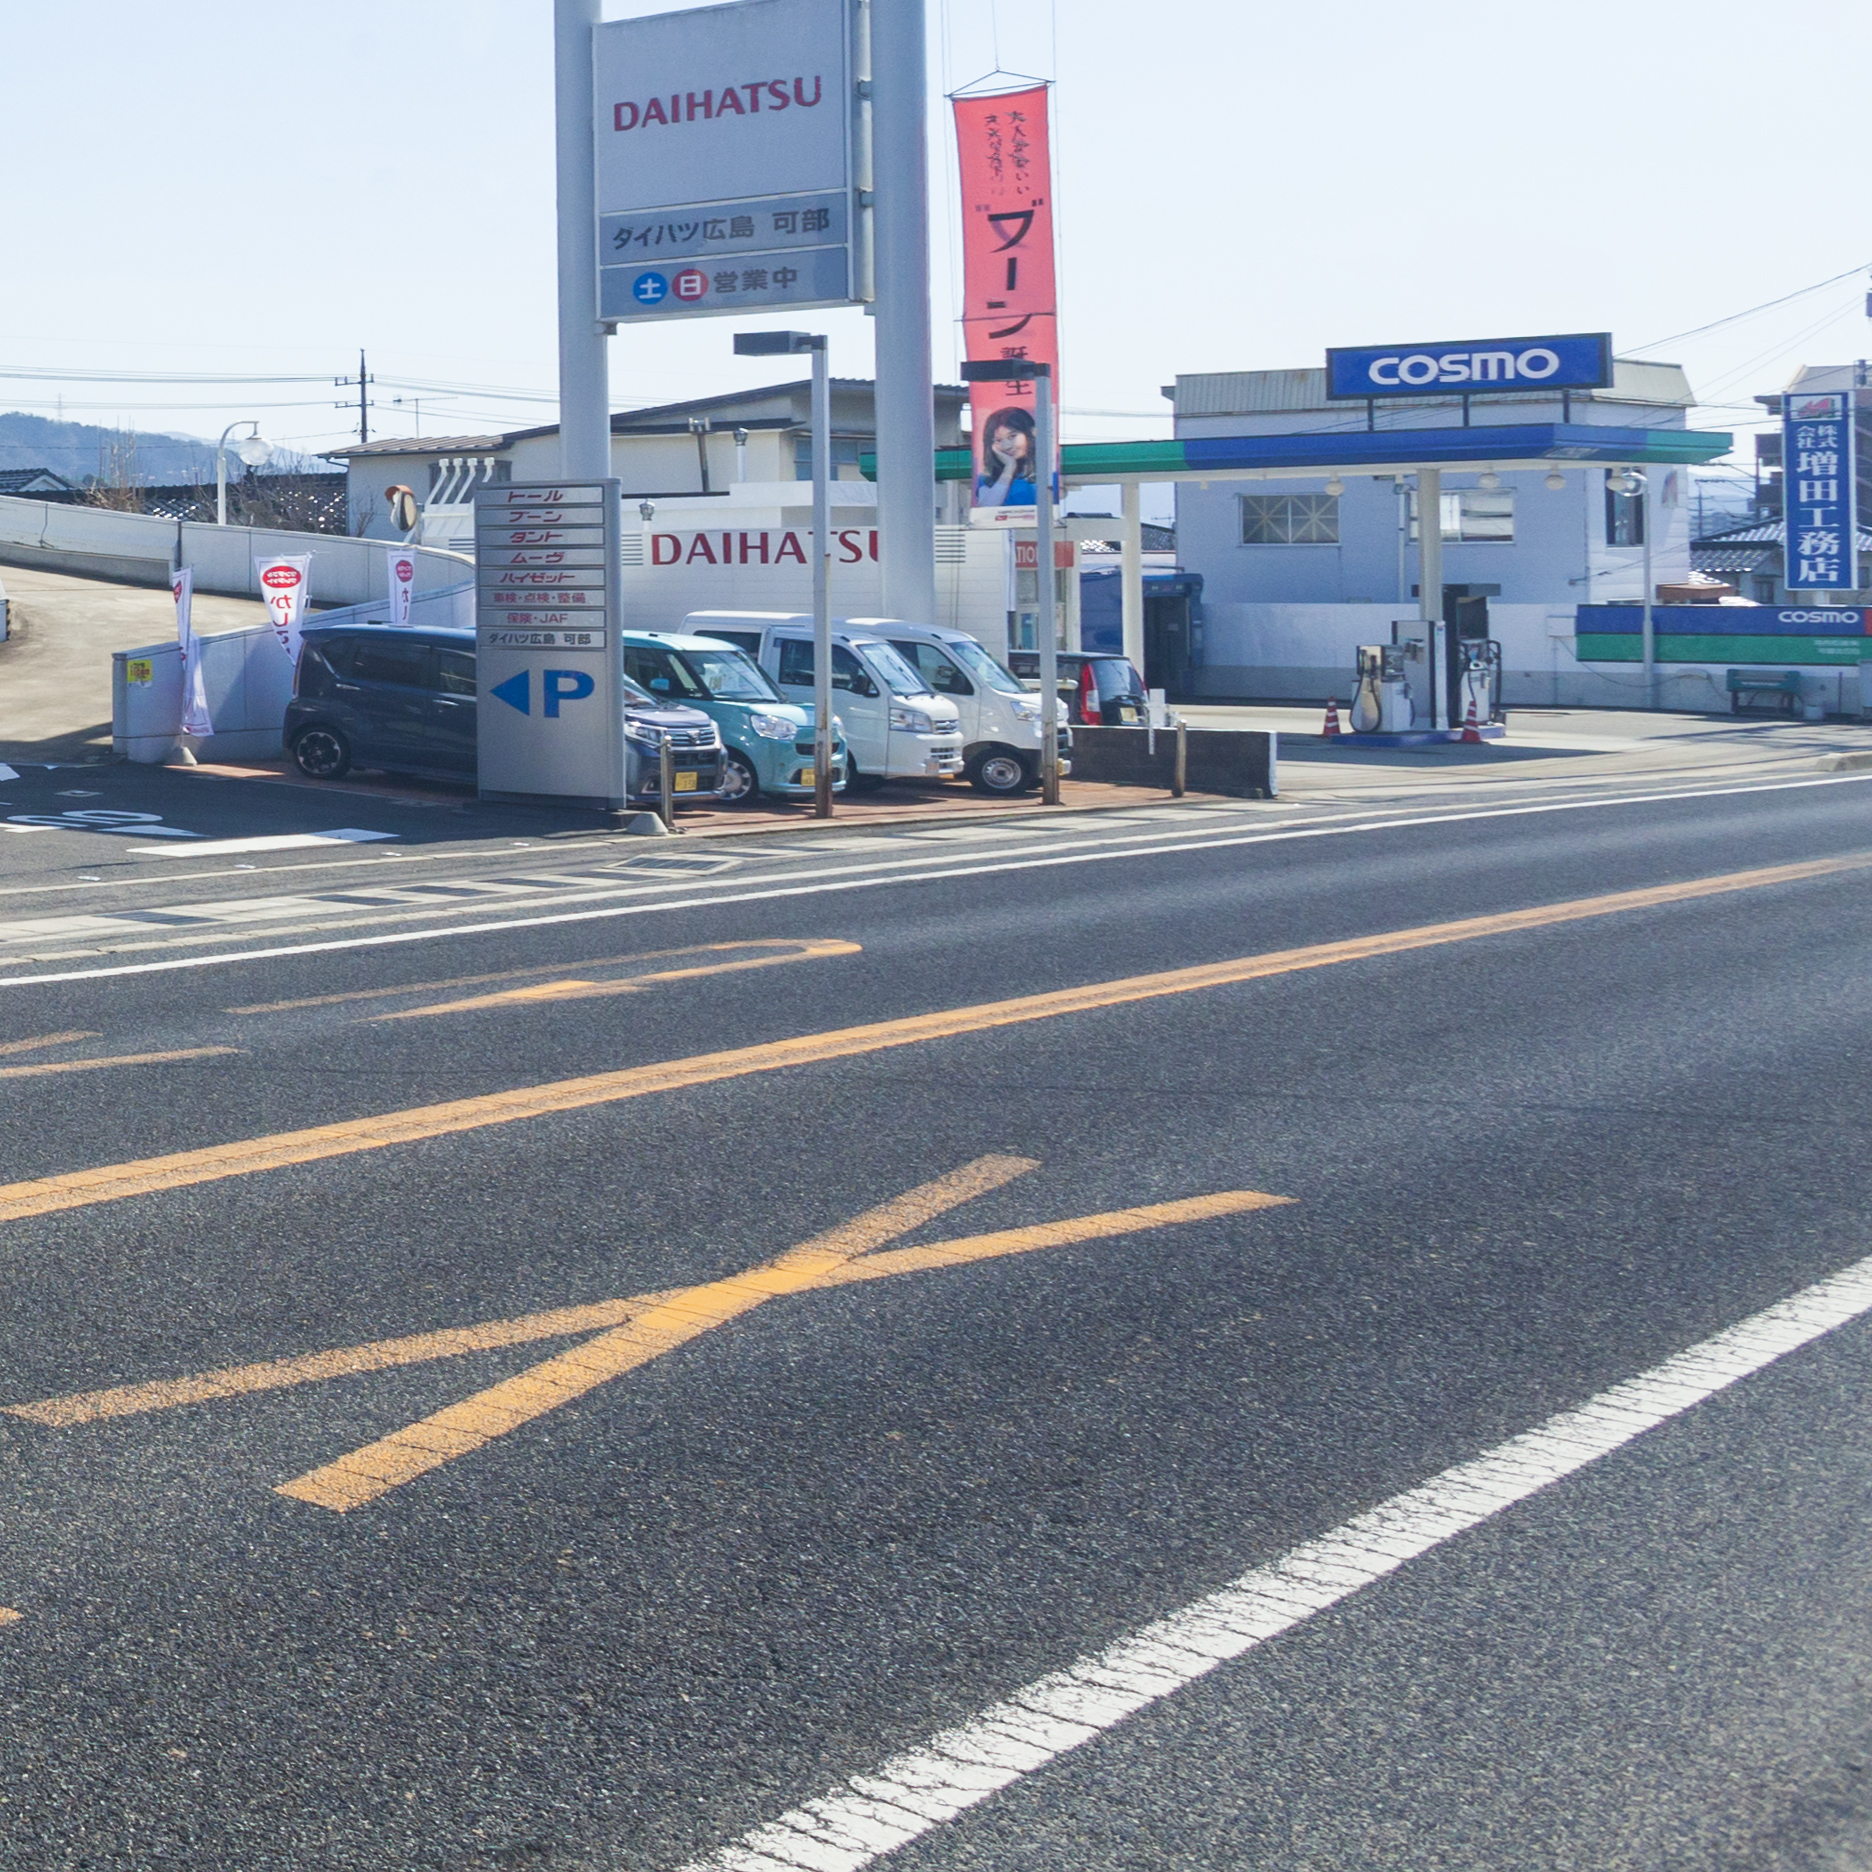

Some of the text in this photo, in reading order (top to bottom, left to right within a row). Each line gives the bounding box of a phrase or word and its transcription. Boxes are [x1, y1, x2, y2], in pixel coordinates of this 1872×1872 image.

[613, 75, 822, 132] DAIHATSU
[612, 208, 831, 251] ダイハツ広島 可部
[986, 197, 1044, 340] ブーン
[713, 266, 798, 294] 営業中
[1368, 348, 1560, 385] COSMO
[507, 489, 564, 503] トール
[509, 510, 563, 523] ブーン
[1796, 450, 1841, 583] 増田工務店
[509, 531, 564, 544] タント
[510, 551, 566, 564] ムーヴ
[499, 571, 576, 584] ハイゼット
[506, 612, 569, 625] 保険・JAF
[1778, 611, 1860, 624] COSMO
[488, 632, 592, 645] ダイハツ広島 可部
[542, 669, 596, 719] P
